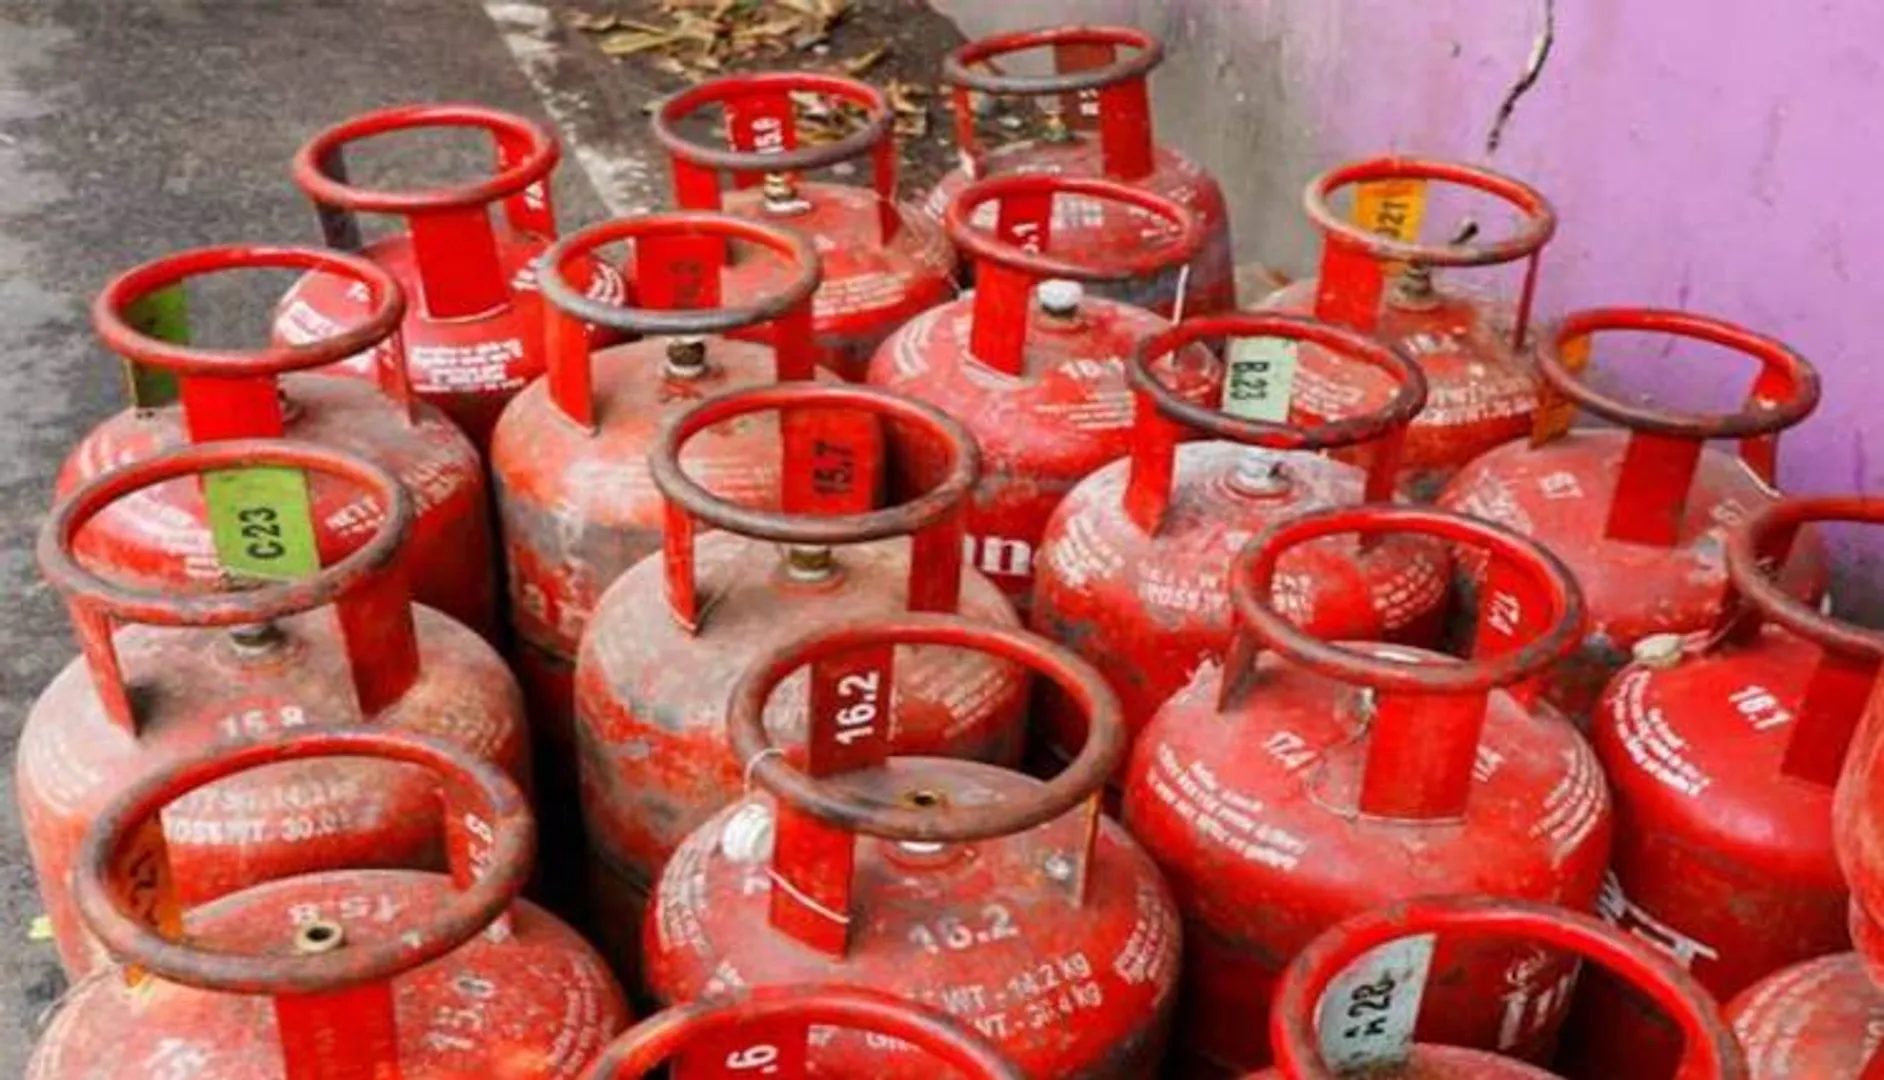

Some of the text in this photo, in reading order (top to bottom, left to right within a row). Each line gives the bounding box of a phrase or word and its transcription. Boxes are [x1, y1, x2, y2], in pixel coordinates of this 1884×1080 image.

[812, 440, 856, 496] 15.7
[238, 506, 286, 561] C23
[834, 670, 879, 745] 16.2
[908, 905, 1019, 953] 16.2
